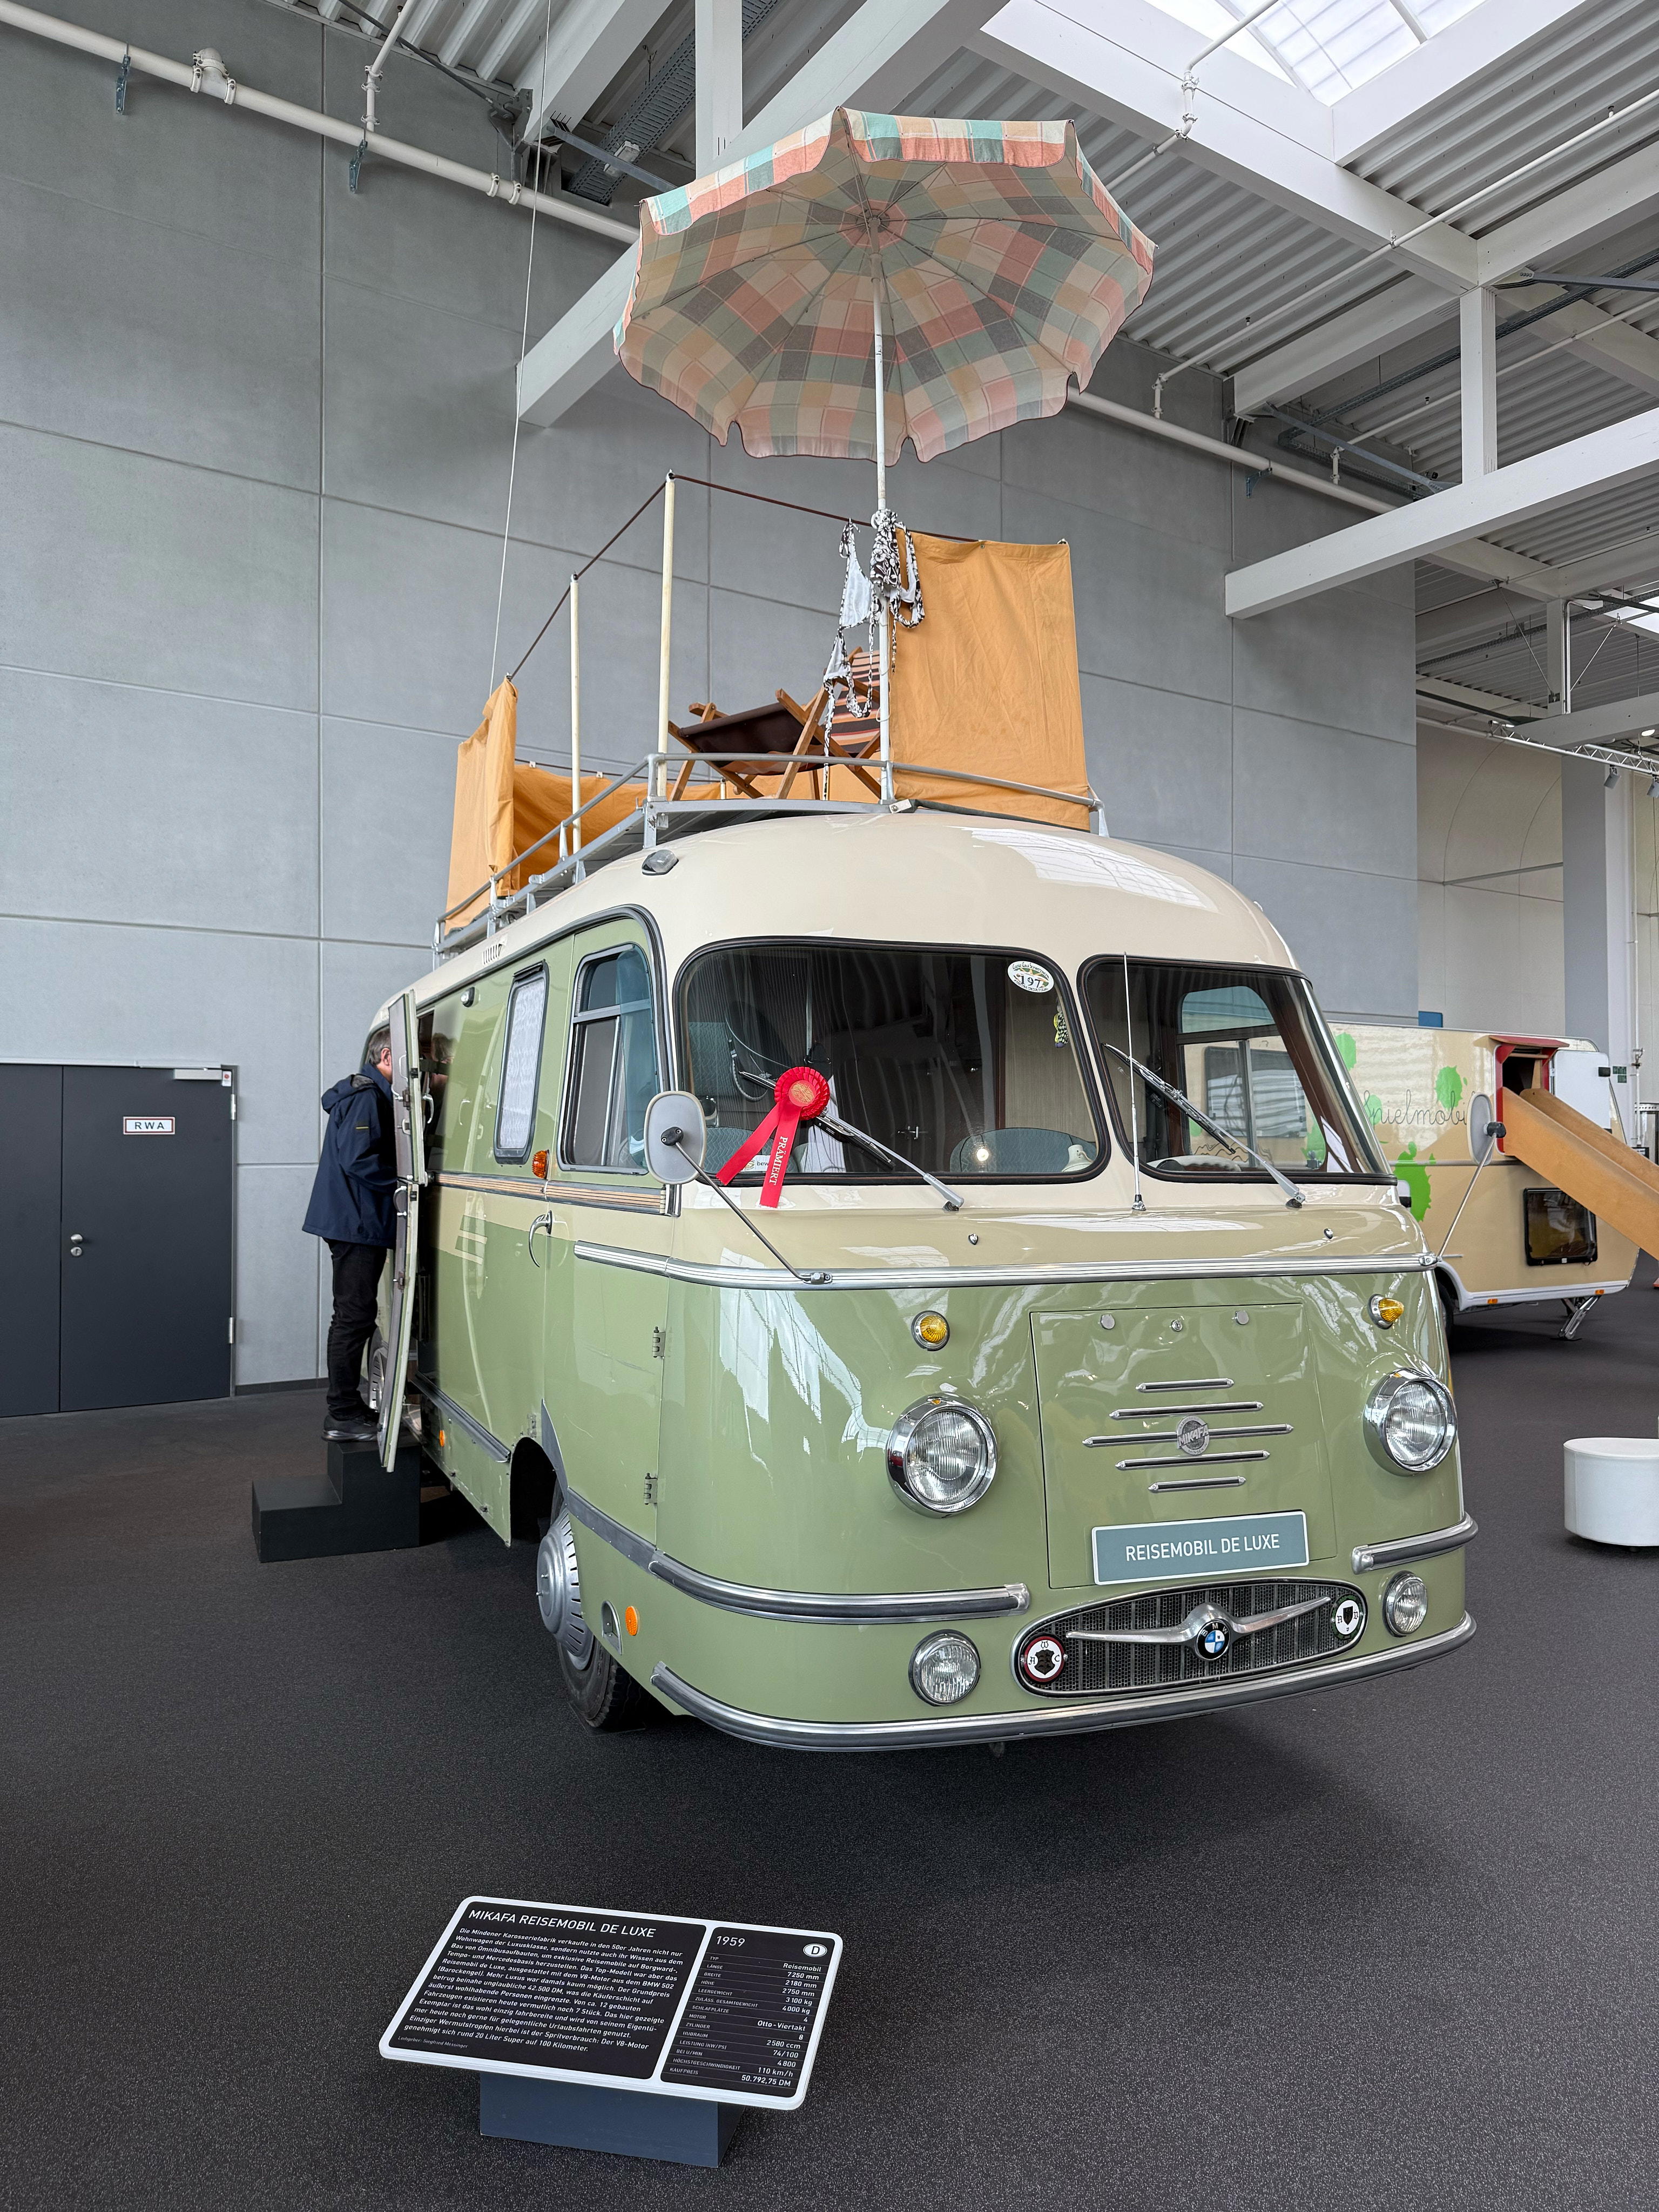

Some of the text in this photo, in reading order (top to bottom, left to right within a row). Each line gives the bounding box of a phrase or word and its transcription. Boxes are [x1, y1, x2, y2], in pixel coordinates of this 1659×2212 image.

[1020, 975, 1042, 988] 197
[1364, 1089, 1475, 1130] Spielmobi
[769, 1136, 788, 1185] PRÄMIERT
[1178, 1424, 1209, 1447] MIKAFA
[1126, 1533, 1280, 1562] REISEMOBIL DE LUXE
[1201, 1622, 1229, 1637] BMW
[468, 1909, 656, 1937] MIKAFA REISEMOBIL DE LUXE
[455, 1935, 493, 1944] Wohnwagen
[507, 1940, 548, 1951] Luxusklasse,
[502, 1932, 556, 1943] Karosseriefabrik
[717, 1936, 745, 1947] 1959
[477, 1945, 539, 1958] Omnibusaufbauten,
[585, 1957, 626, 1967] Reisemobile
[640, 1963, 677, 1973] Borgward-,
[811, 1946, 820, 1955] D
[442, 1958, 478, 1967] Reisemobil
[508, 1966, 549, 1975] ausgestattet
[579, 1973, 611, 1982] V8-Motor
[447, 1950, 470, 1958] Tempo-
[485, 1954, 534, 1965] Mercedesbasis
[535, 1960, 578, 1970] herzustellen.
[595, 1966, 632, 1976] Top-Modell
[783, 1963, 821, 1972] Reisemobil
[428, 1981, 454, 1990] äußerst
[455, 1986, 499, 1995] wohlhabende
[500, 1990, 532, 1999] Personen
[533, 1994, 571, 2004] eingrenzte.
[608, 2004, 640, 2012] gebauten
[433, 1973, 455, 1982] betrug
[455, 1976, 482, 1984] beinahe
[483, 1980, 526, 1990] unglaubliche
[592, 1992, 640, 2002] Käuferschicht
[409, 2015, 437, 2024] Einziger
[439, 2018, 494, 2031] Wermutstropfen
[494, 2025, 520, 2033] hierbei
[544, 2031, 599, 2044] Spritverbrauch:
[616, 2040, 649, 2049] V8-Motor
[500, 2018, 547, 2027] gelegentliche
[549, 2022, 601, 2034] Urlaubsfahrten
[403, 2025, 441, 2034] genehmigt
[502, 2035, 524, 2044] Super
[552, 2041, 588, 2051] Kilometer.
[773, 2049, 799, 2058] 74/100
[741, 2074, 791, 2087] 50.792,75 DM
[772, 2068, 793, 2077] km/h
